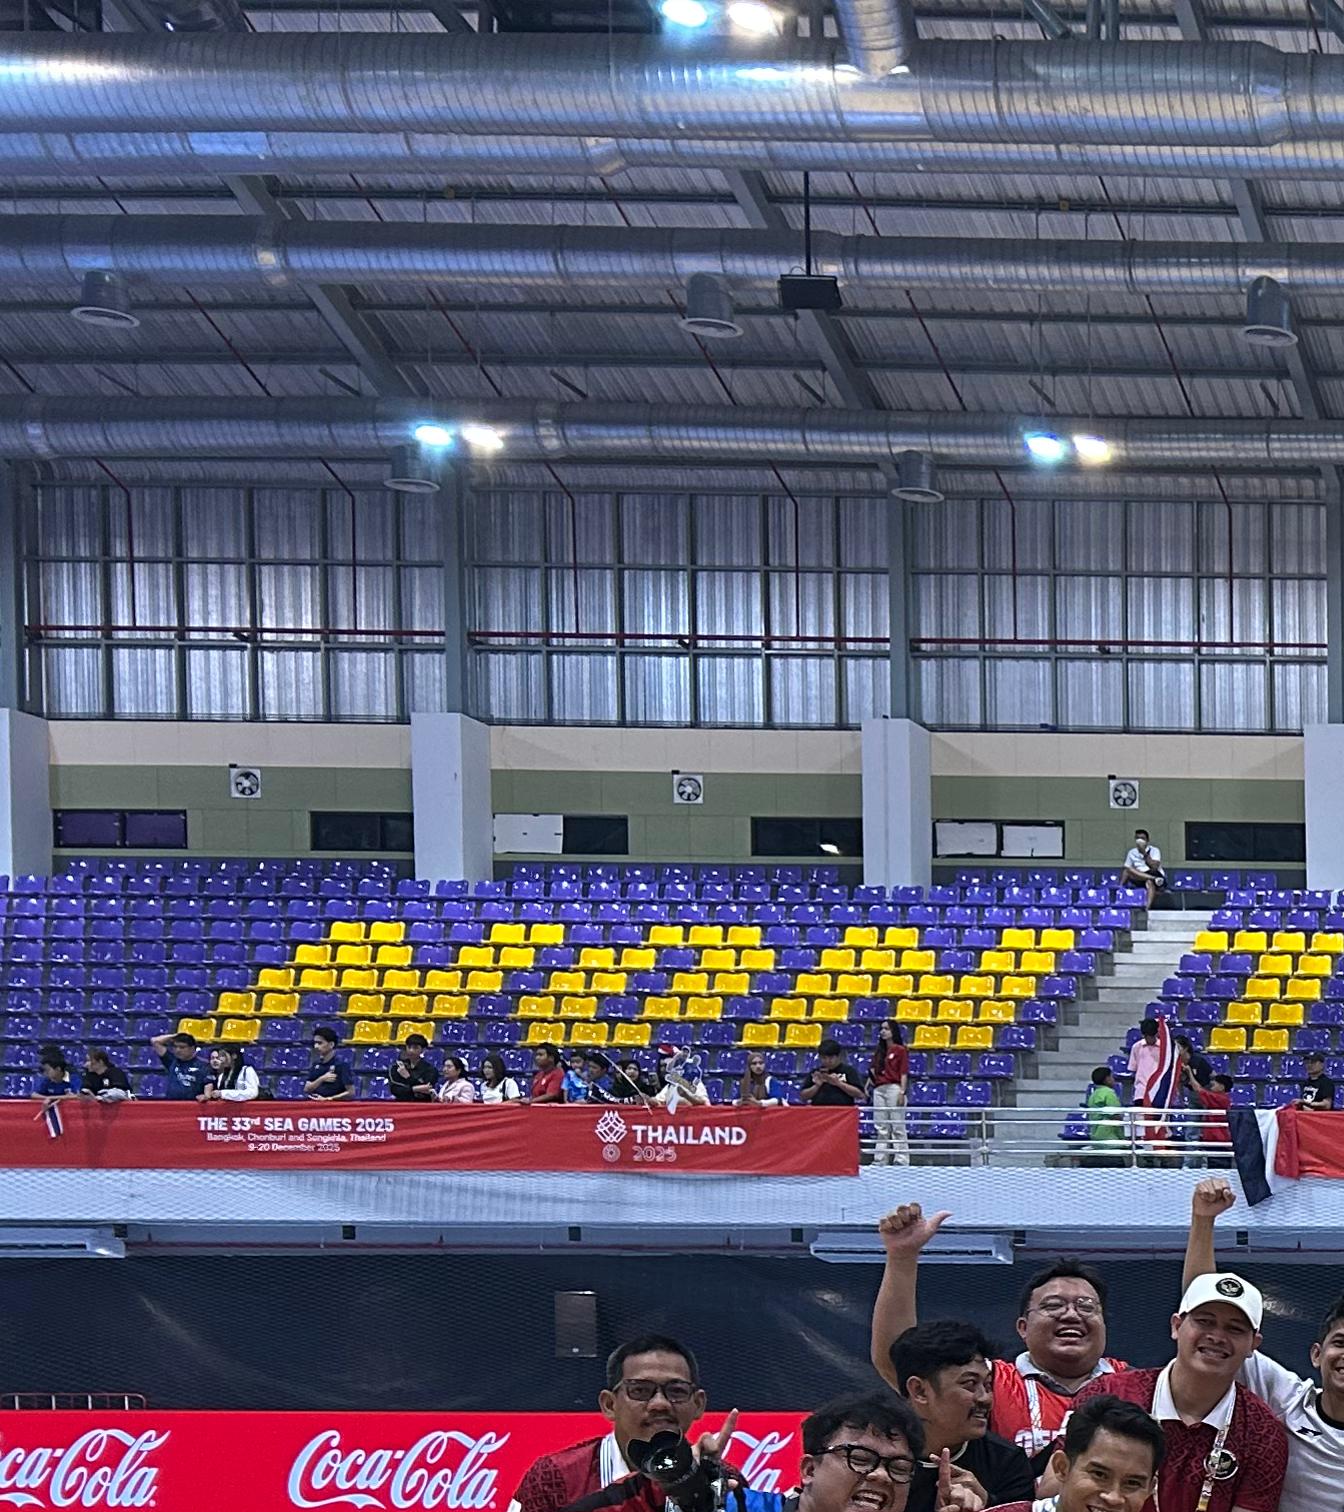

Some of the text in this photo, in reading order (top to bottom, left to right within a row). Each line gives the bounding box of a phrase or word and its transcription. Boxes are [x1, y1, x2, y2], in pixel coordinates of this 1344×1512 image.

[197, 1117, 228, 1131] THE
[264, 1117, 294, 1131] SEA
[298, 1118, 351, 1131] GAMES
[356, 1118, 394, 1132] 2025
[632, 1125, 747, 1145] THAILAND
[632, 1146, 677, 1162] 2025
[0, 1429, 171, 1508] ca-Cola
[289, 1430, 510, 1510] Coca-Cola
